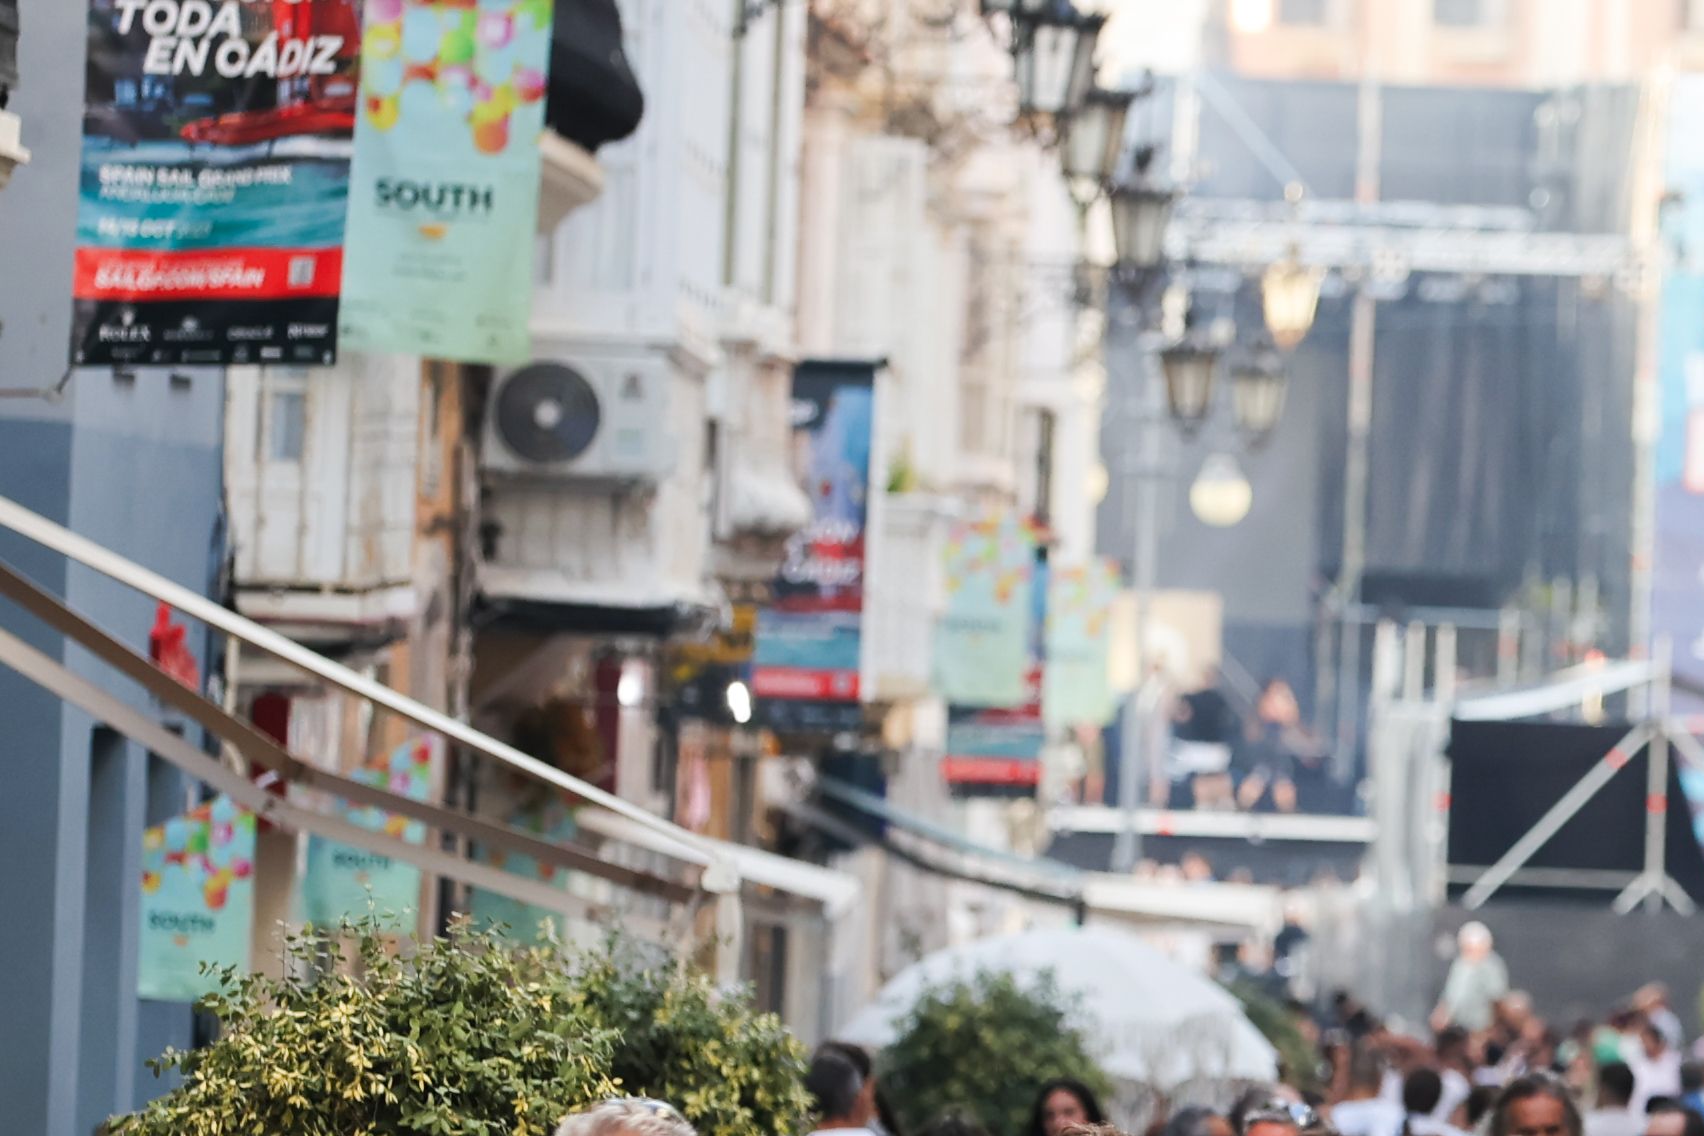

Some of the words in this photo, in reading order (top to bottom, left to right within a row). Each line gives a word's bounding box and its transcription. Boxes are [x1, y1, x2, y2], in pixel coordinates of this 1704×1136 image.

[114, 0, 242, 37] TODA
[143, 37, 211, 76] EN
[214, 31, 344, 77] CÁDIZ
[375, 177, 494, 214] SOUTH
